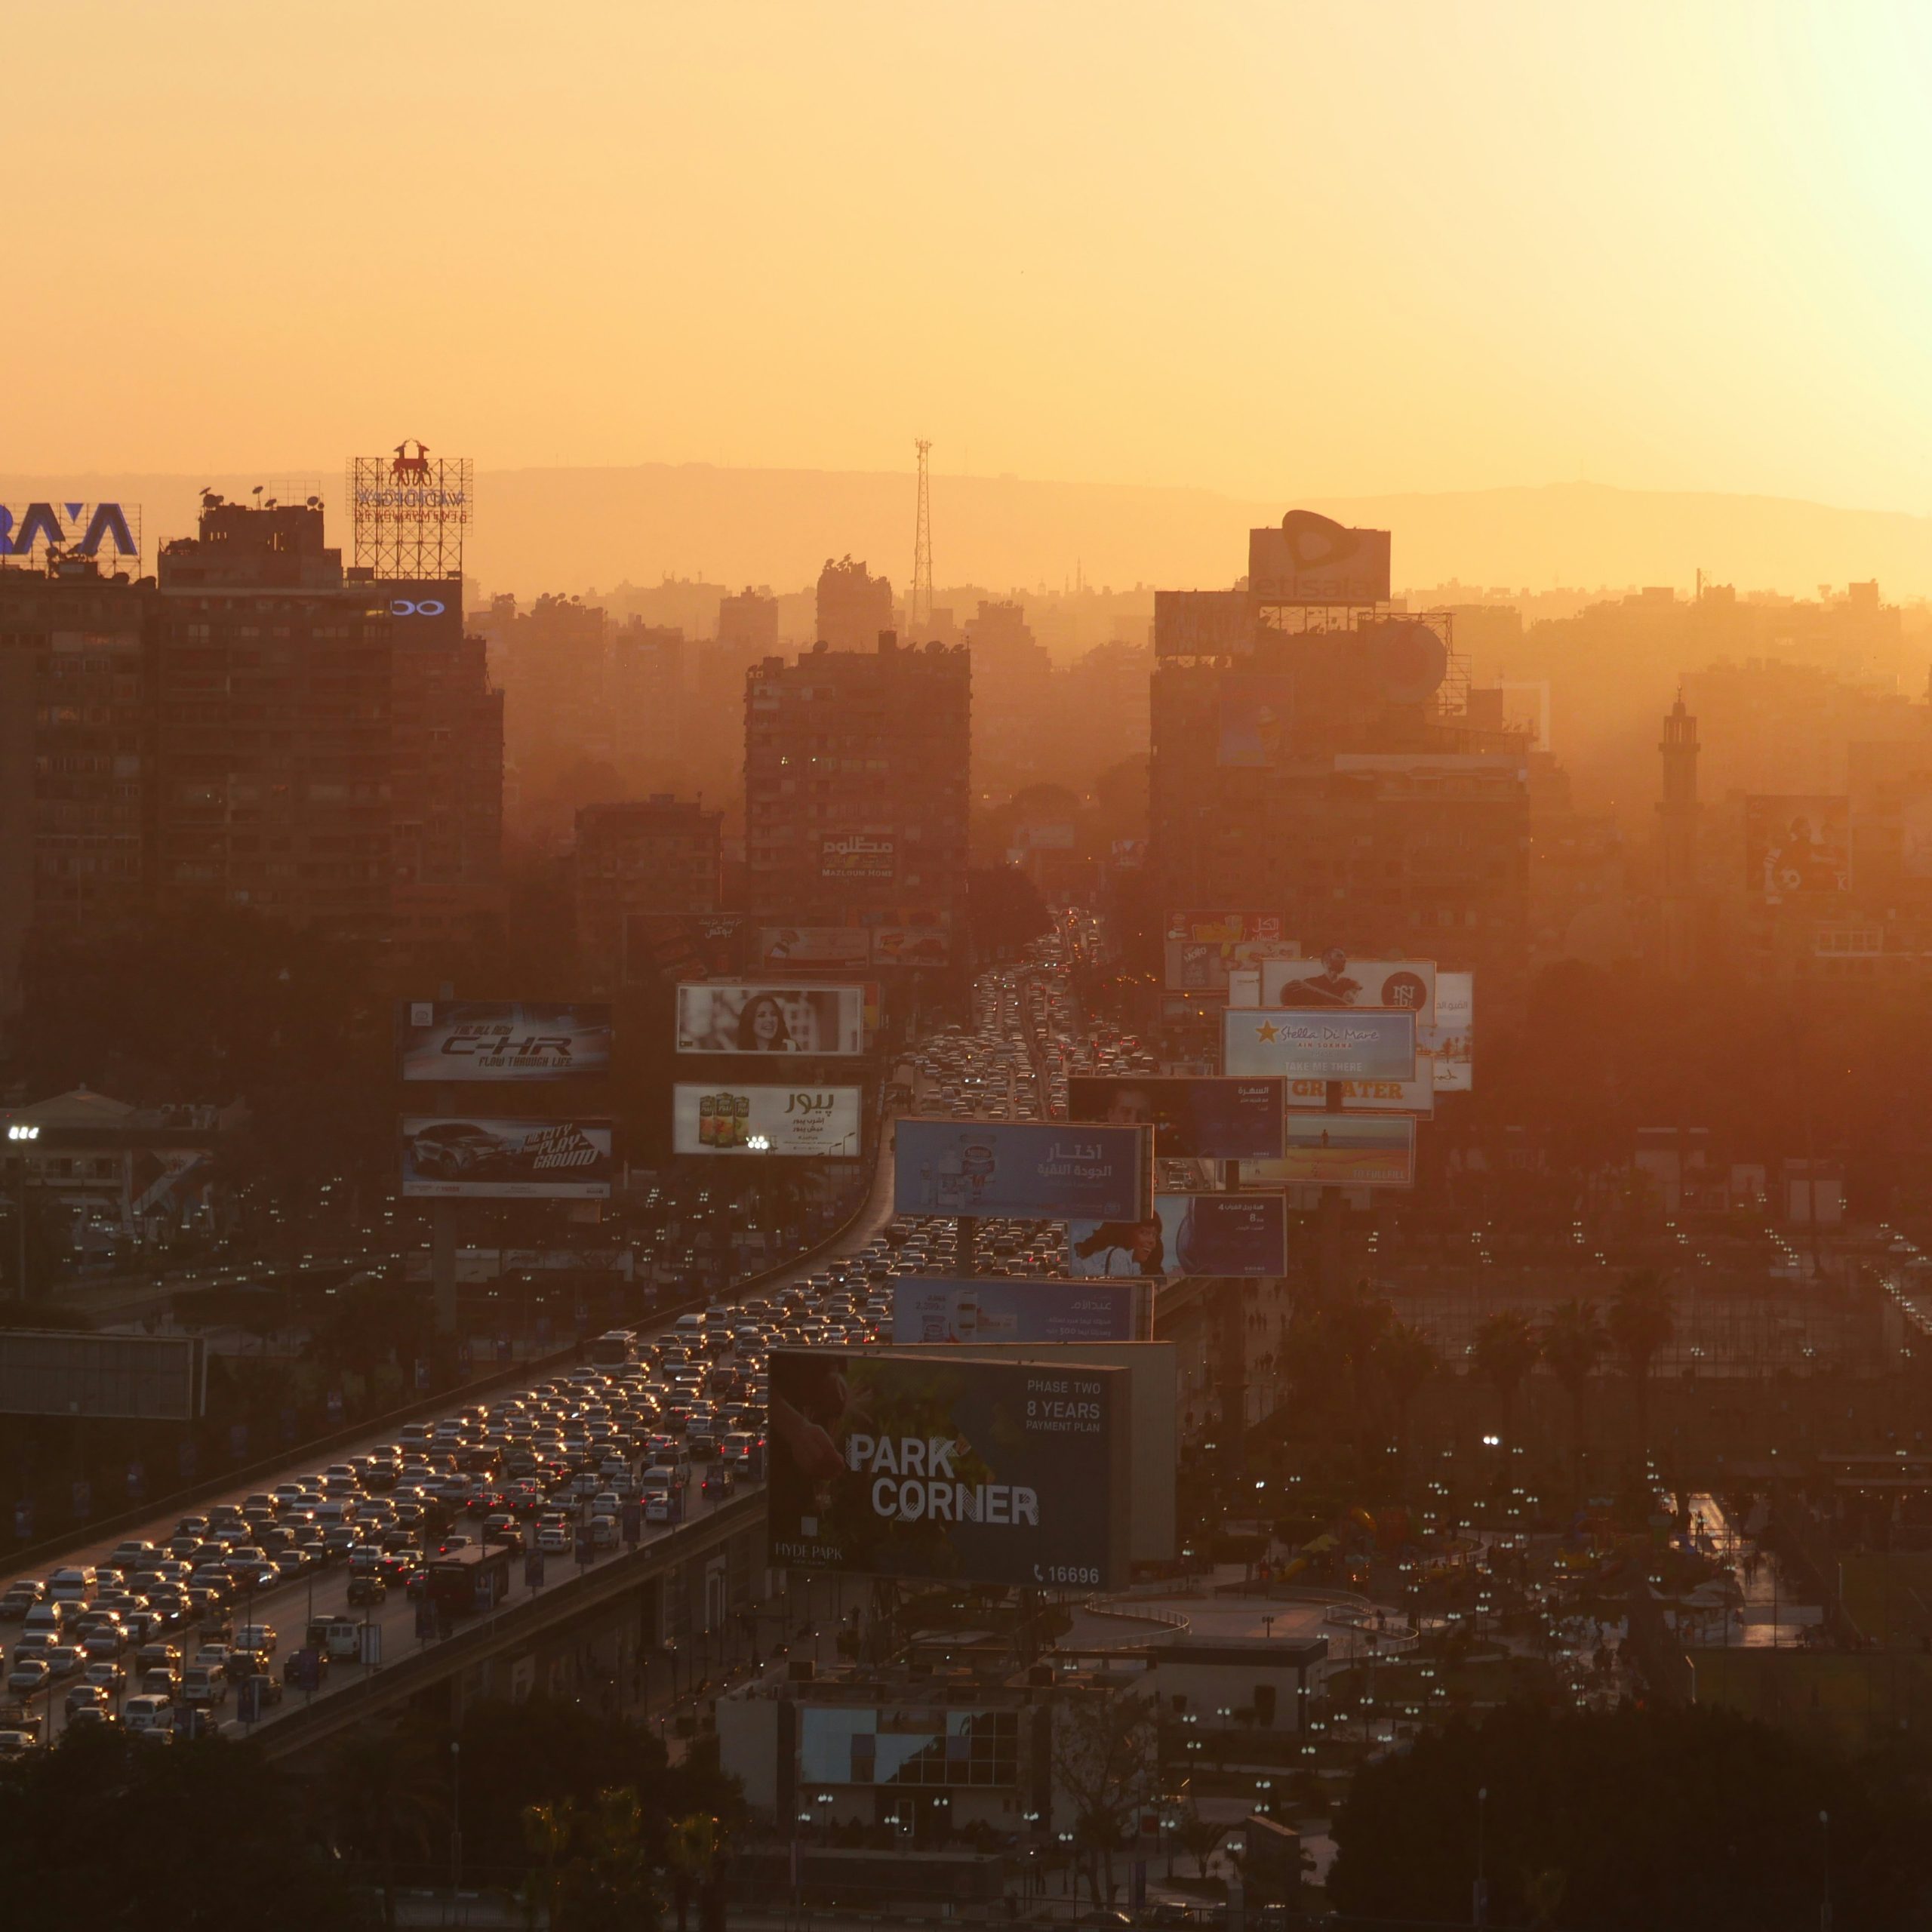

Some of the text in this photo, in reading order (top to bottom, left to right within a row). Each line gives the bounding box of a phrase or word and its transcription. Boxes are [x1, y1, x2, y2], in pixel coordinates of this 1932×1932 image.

[821, 835, 894, 854] مظلوم
[1280, 1025, 1379, 1041] Stella Di Mare
[441, 1036, 572, 1057] C-HR
[508, 1057, 549, 1067] THROUGH
[552, 1057, 573, 1067] LIFE
[1285, 1062, 1363, 1072] TAKE ME THERE
[1292, 1080, 1404, 1099] GRATER
[533, 1149, 599, 1169] GROUND
[1249, 1213, 1256, 1222] 8
[1027, 1380, 1100, 1395] PHASE TWO
[1027, 1400, 1100, 1420] 8 YEARS
[1026, 1420, 1100, 1432] PAYMENT PLAN
[845, 1433, 958, 1478] PARK
[872, 1477, 1039, 1526] CORNER
[775, 1542, 843, 1561] HYDE PARK
[1049, 1566, 1099, 1584] 16696
